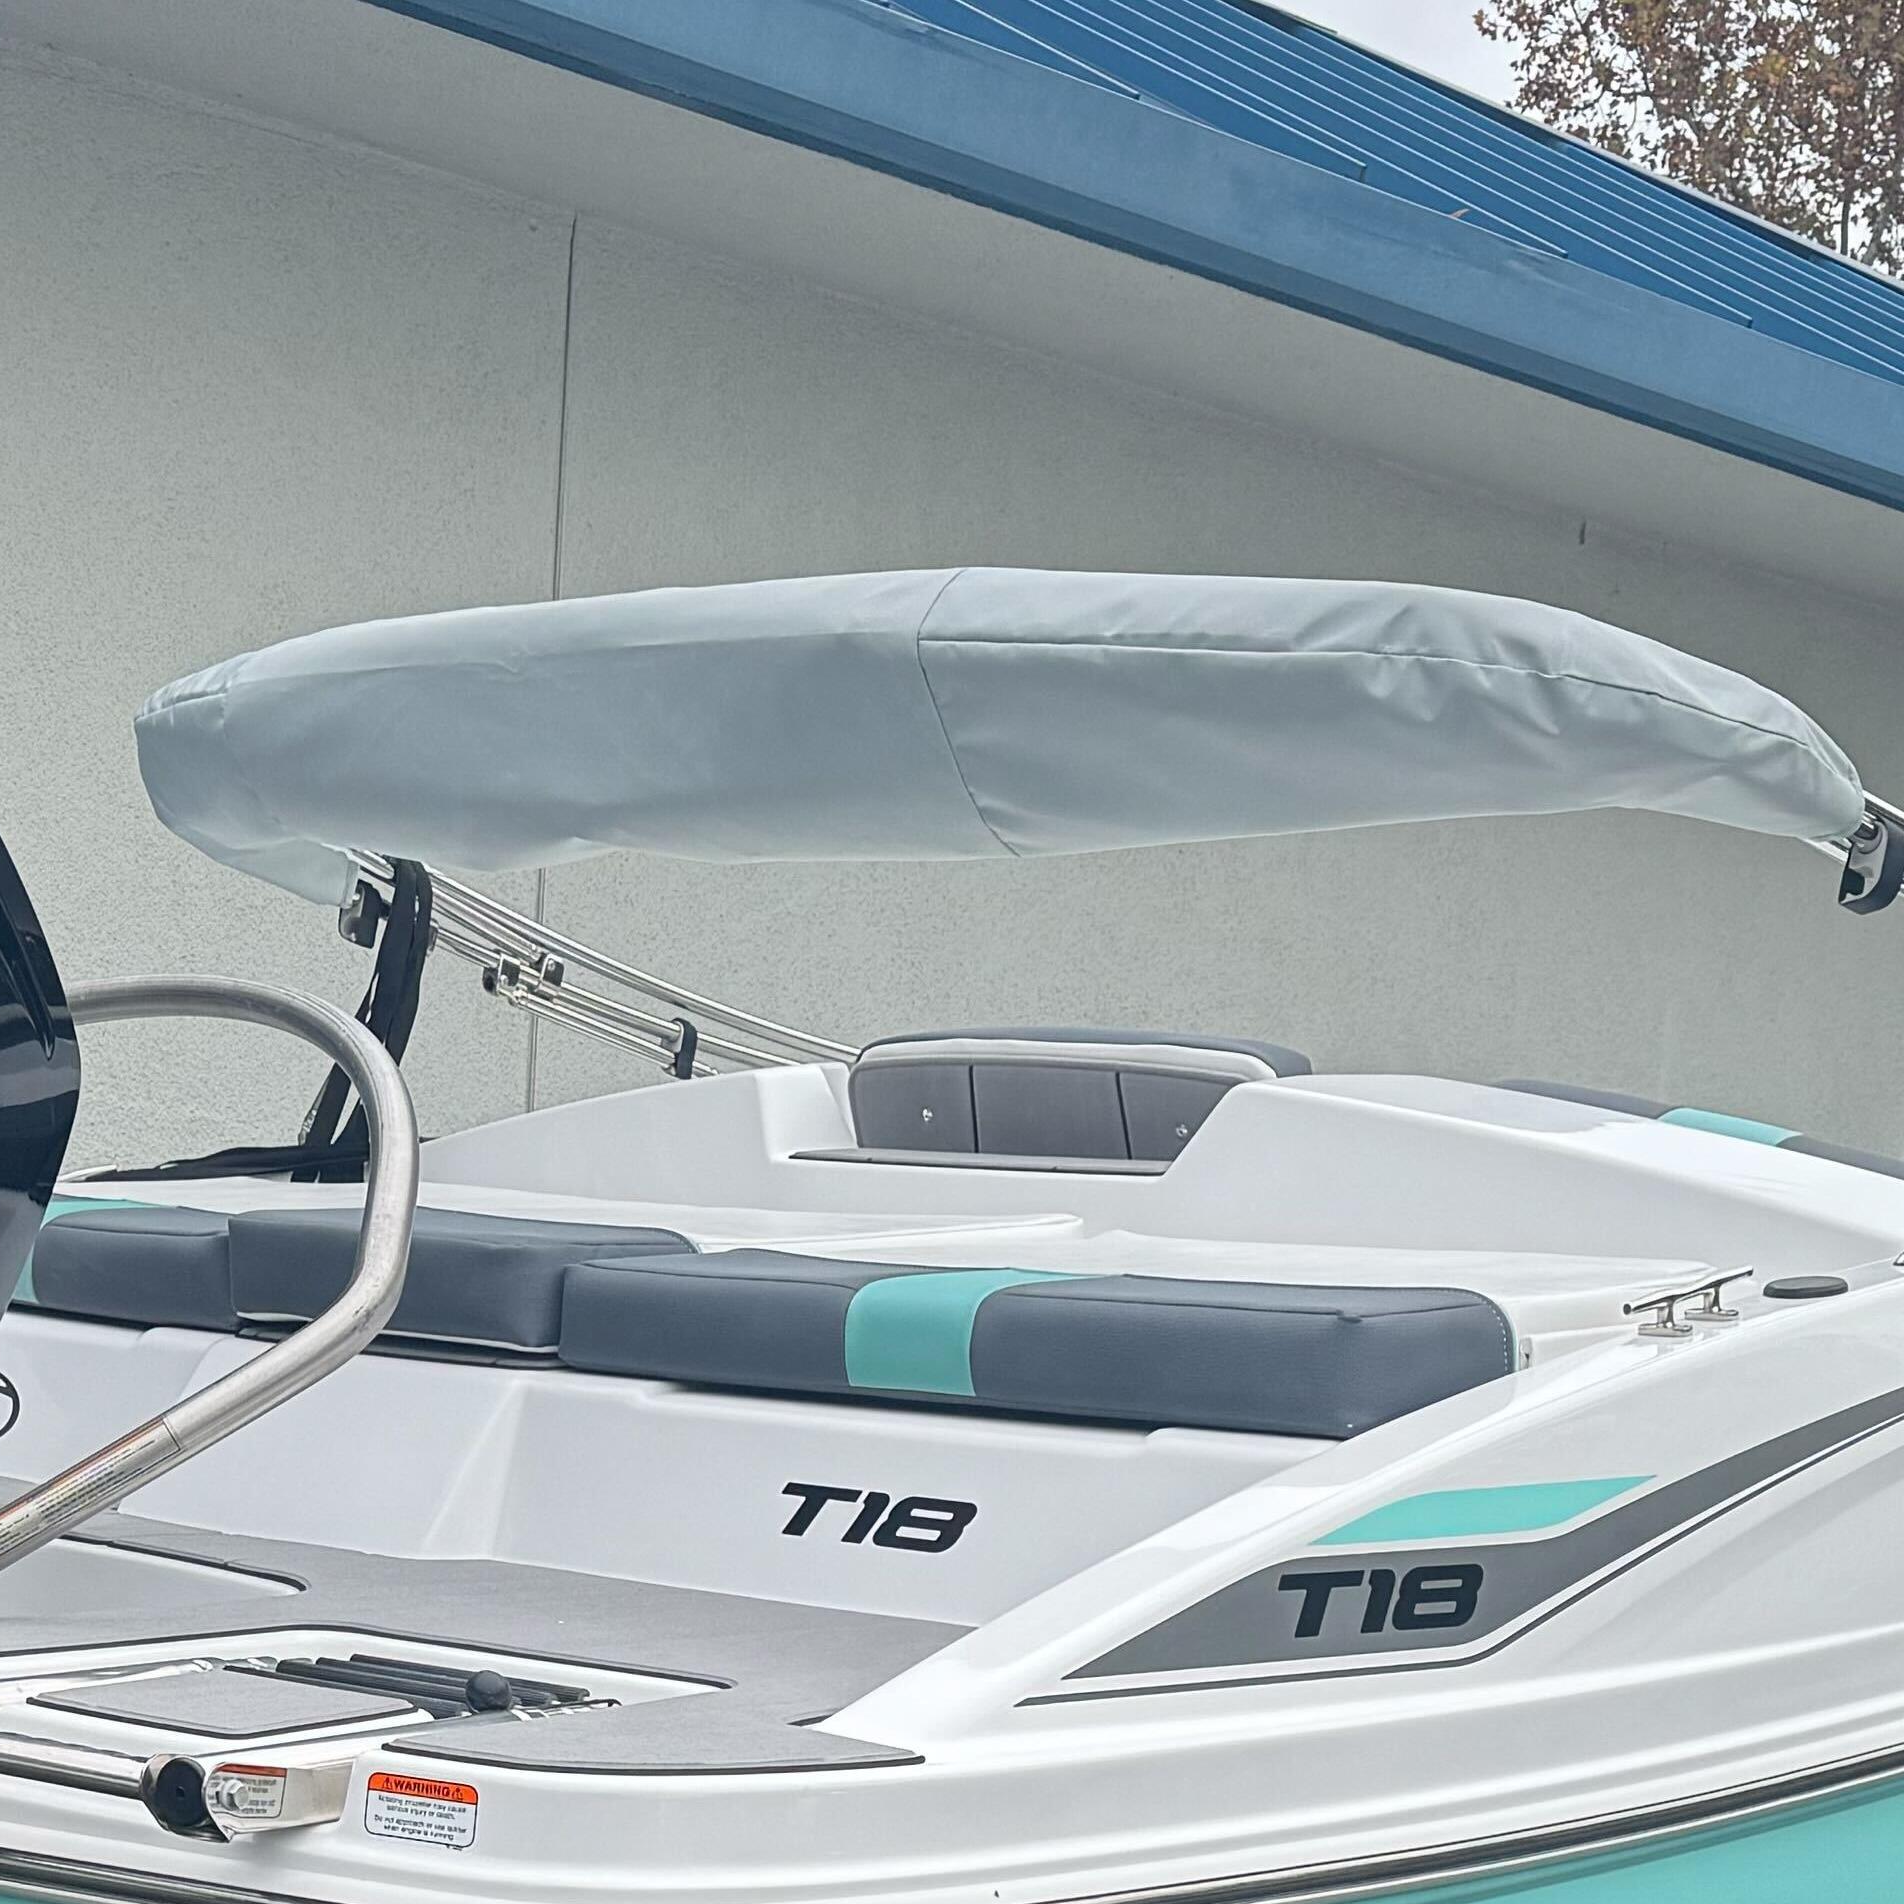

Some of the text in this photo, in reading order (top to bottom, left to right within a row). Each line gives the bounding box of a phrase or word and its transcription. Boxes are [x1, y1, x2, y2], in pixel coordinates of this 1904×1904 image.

[780, 1480, 978, 1554] T18
[1277, 1562, 1484, 1639] T18
[394, 1778, 450, 1797] WARNING
